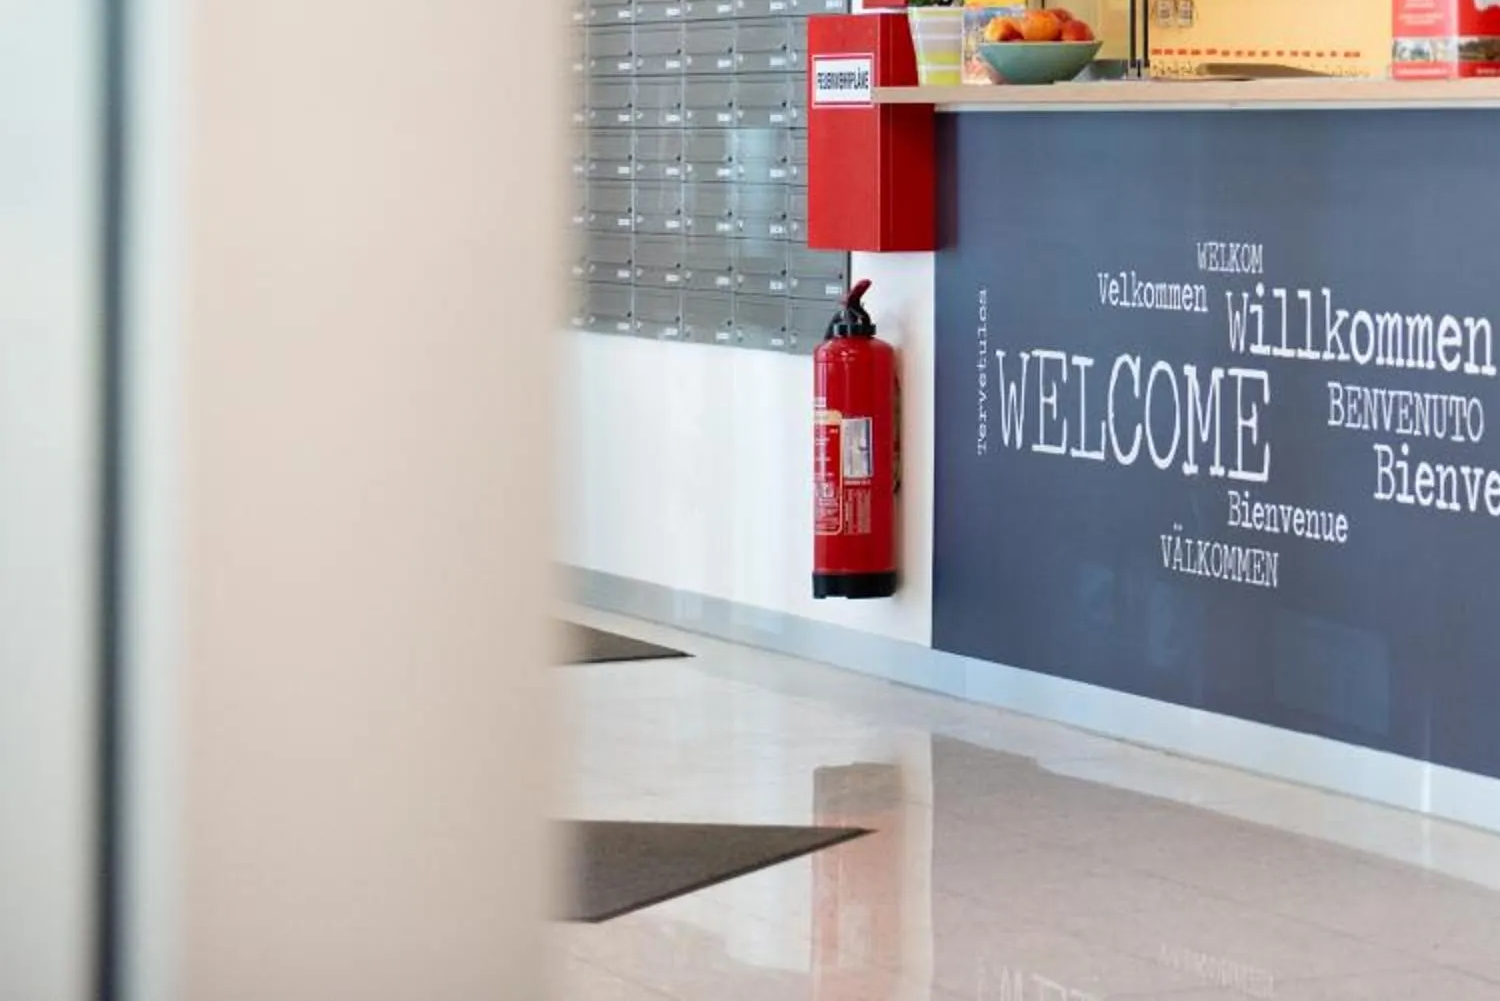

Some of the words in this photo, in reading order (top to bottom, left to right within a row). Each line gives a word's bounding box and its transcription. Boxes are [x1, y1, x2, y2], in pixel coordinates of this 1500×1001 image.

[1197, 241, 1263, 274] WELKOM
[1098, 272, 1208, 313] Velkommen
[1226, 283, 1497, 377] Willkommen
[996, 348, 1271, 482] WELCOME
[1328, 381, 1484, 442] BENVENUTO
[1228, 490, 1349, 543] Bienvenue
[1160, 524, 1279, 588] VÄLKOMMEN
